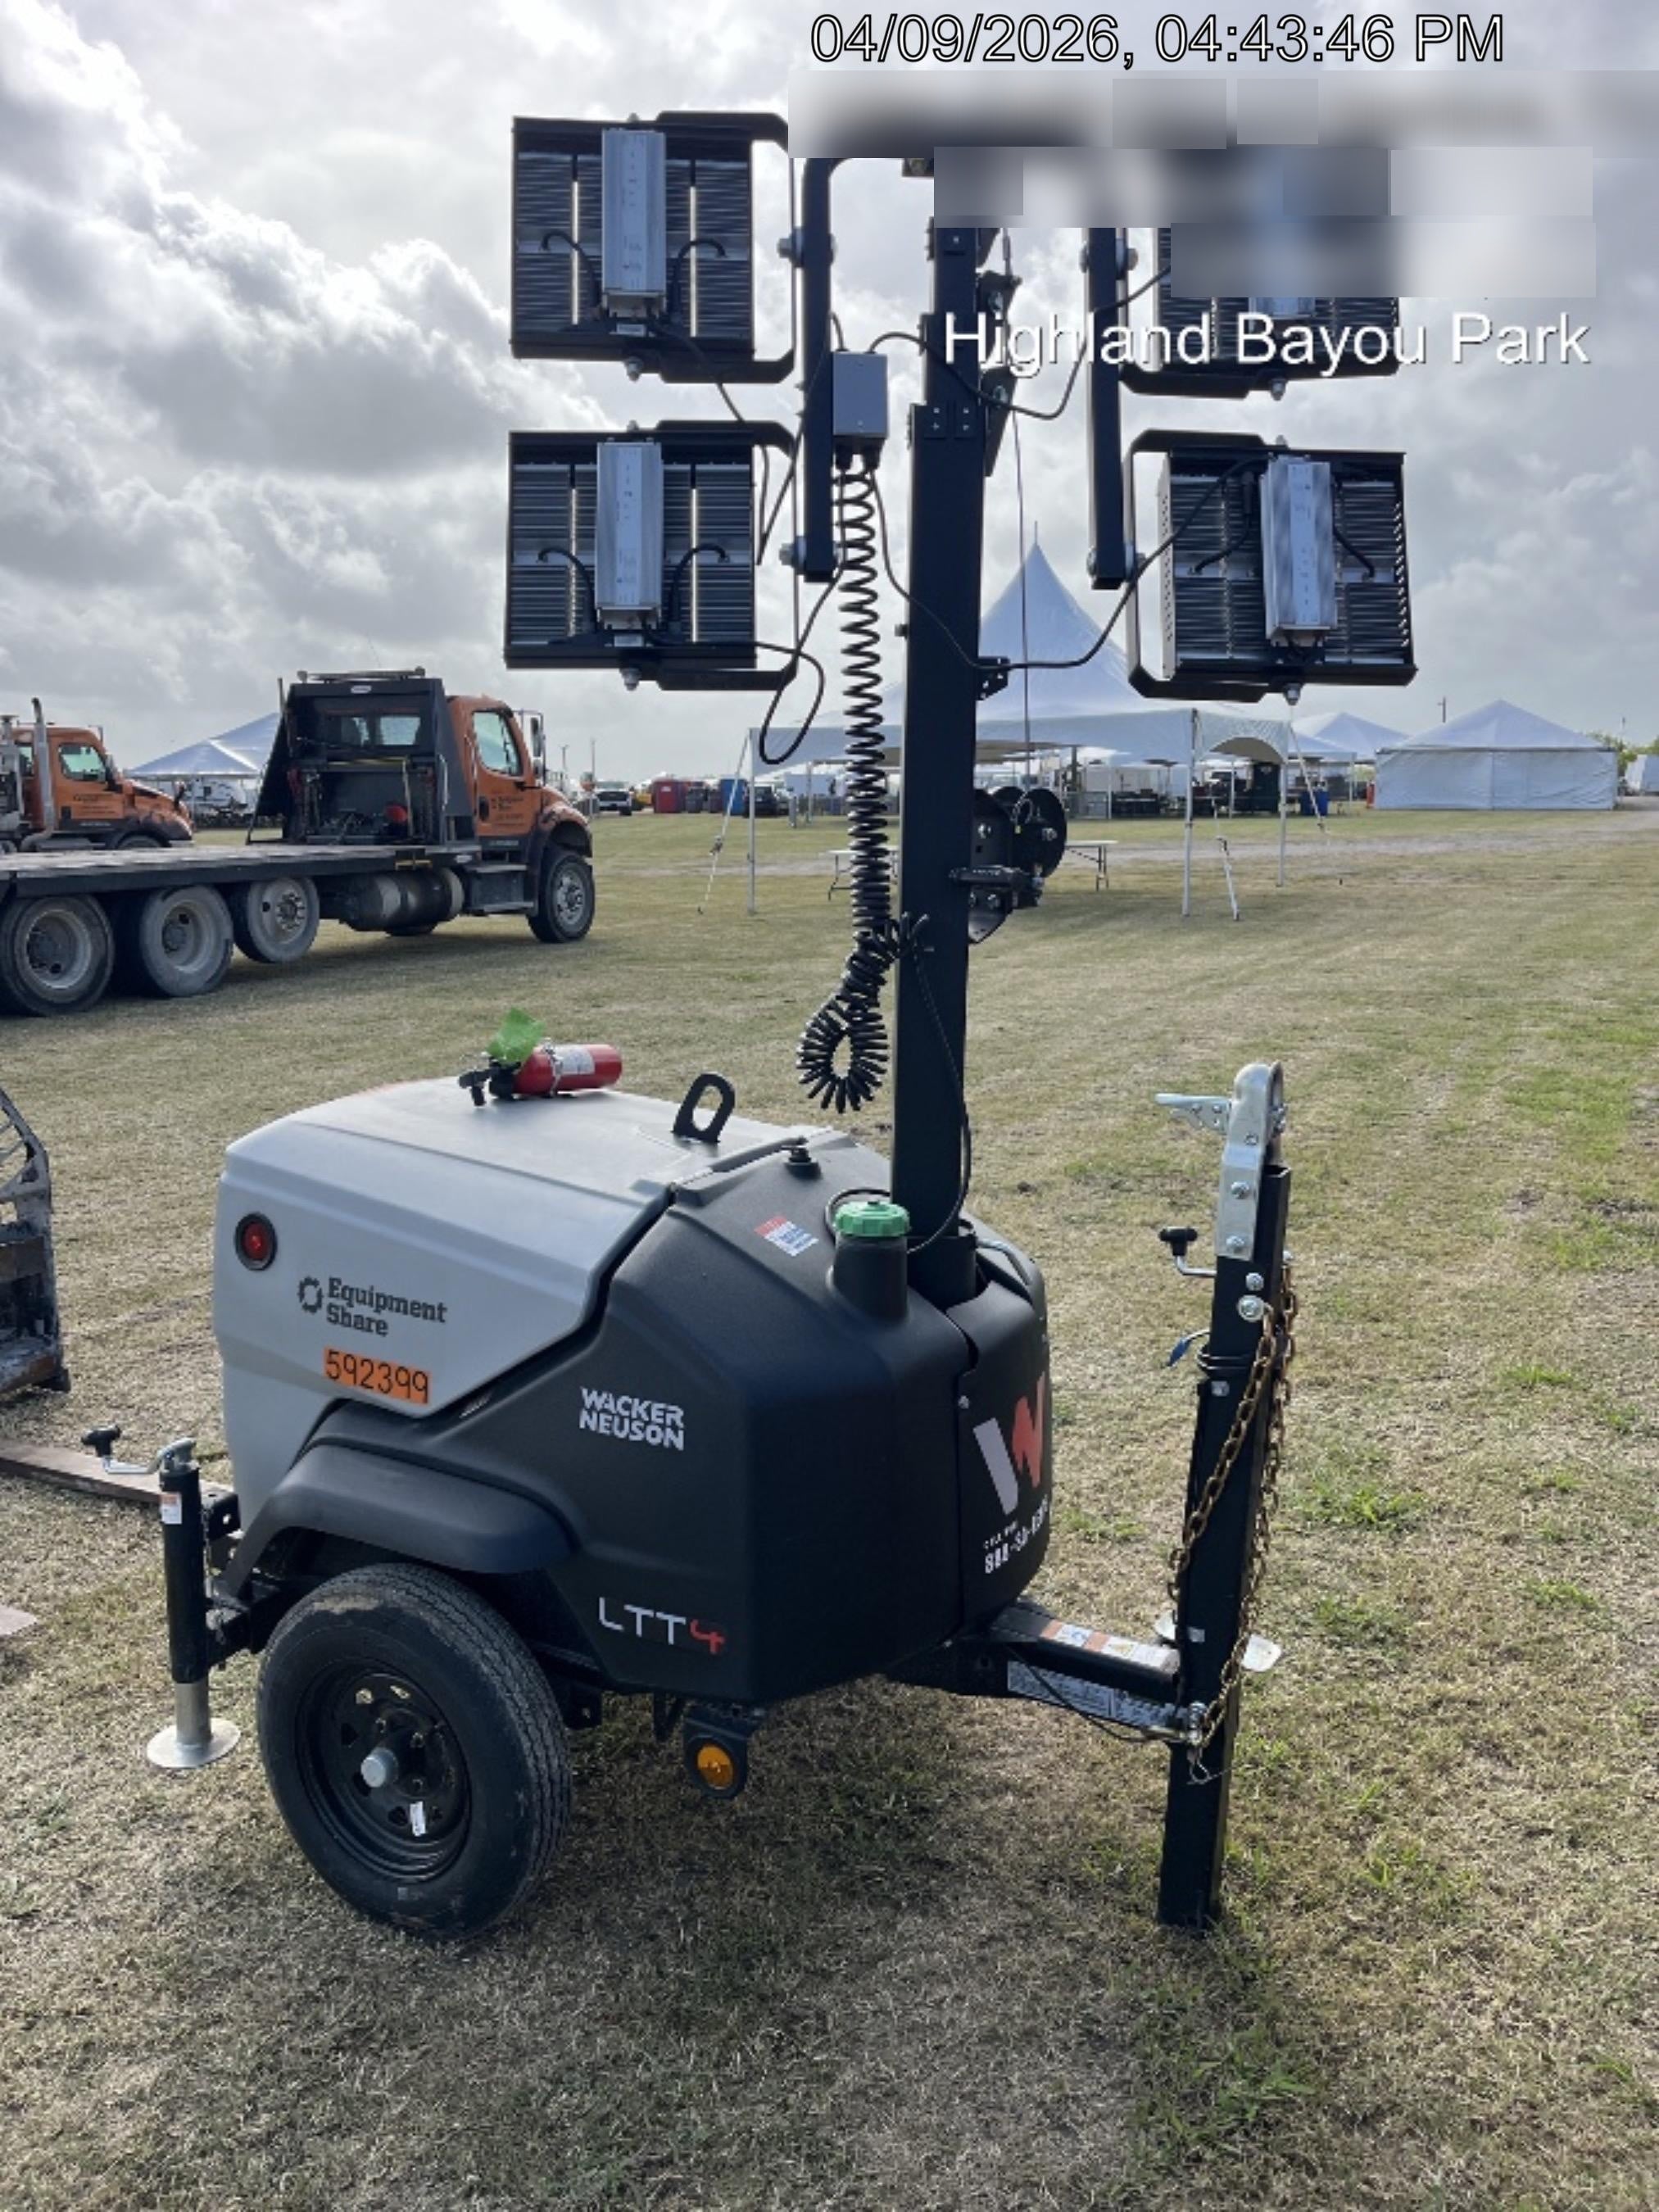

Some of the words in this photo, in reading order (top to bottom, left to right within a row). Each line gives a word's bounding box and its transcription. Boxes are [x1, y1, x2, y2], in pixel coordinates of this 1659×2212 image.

[326, 1302, 388, 1337] Share
[328, 1276, 448, 1323] Equipment
[326, 1349, 428, 1403] 592399
[579, 1408, 684, 1451] NEUSON
[581, 1386, 684, 1428] WACKER
[598, 1597, 725, 1654] LTT4
